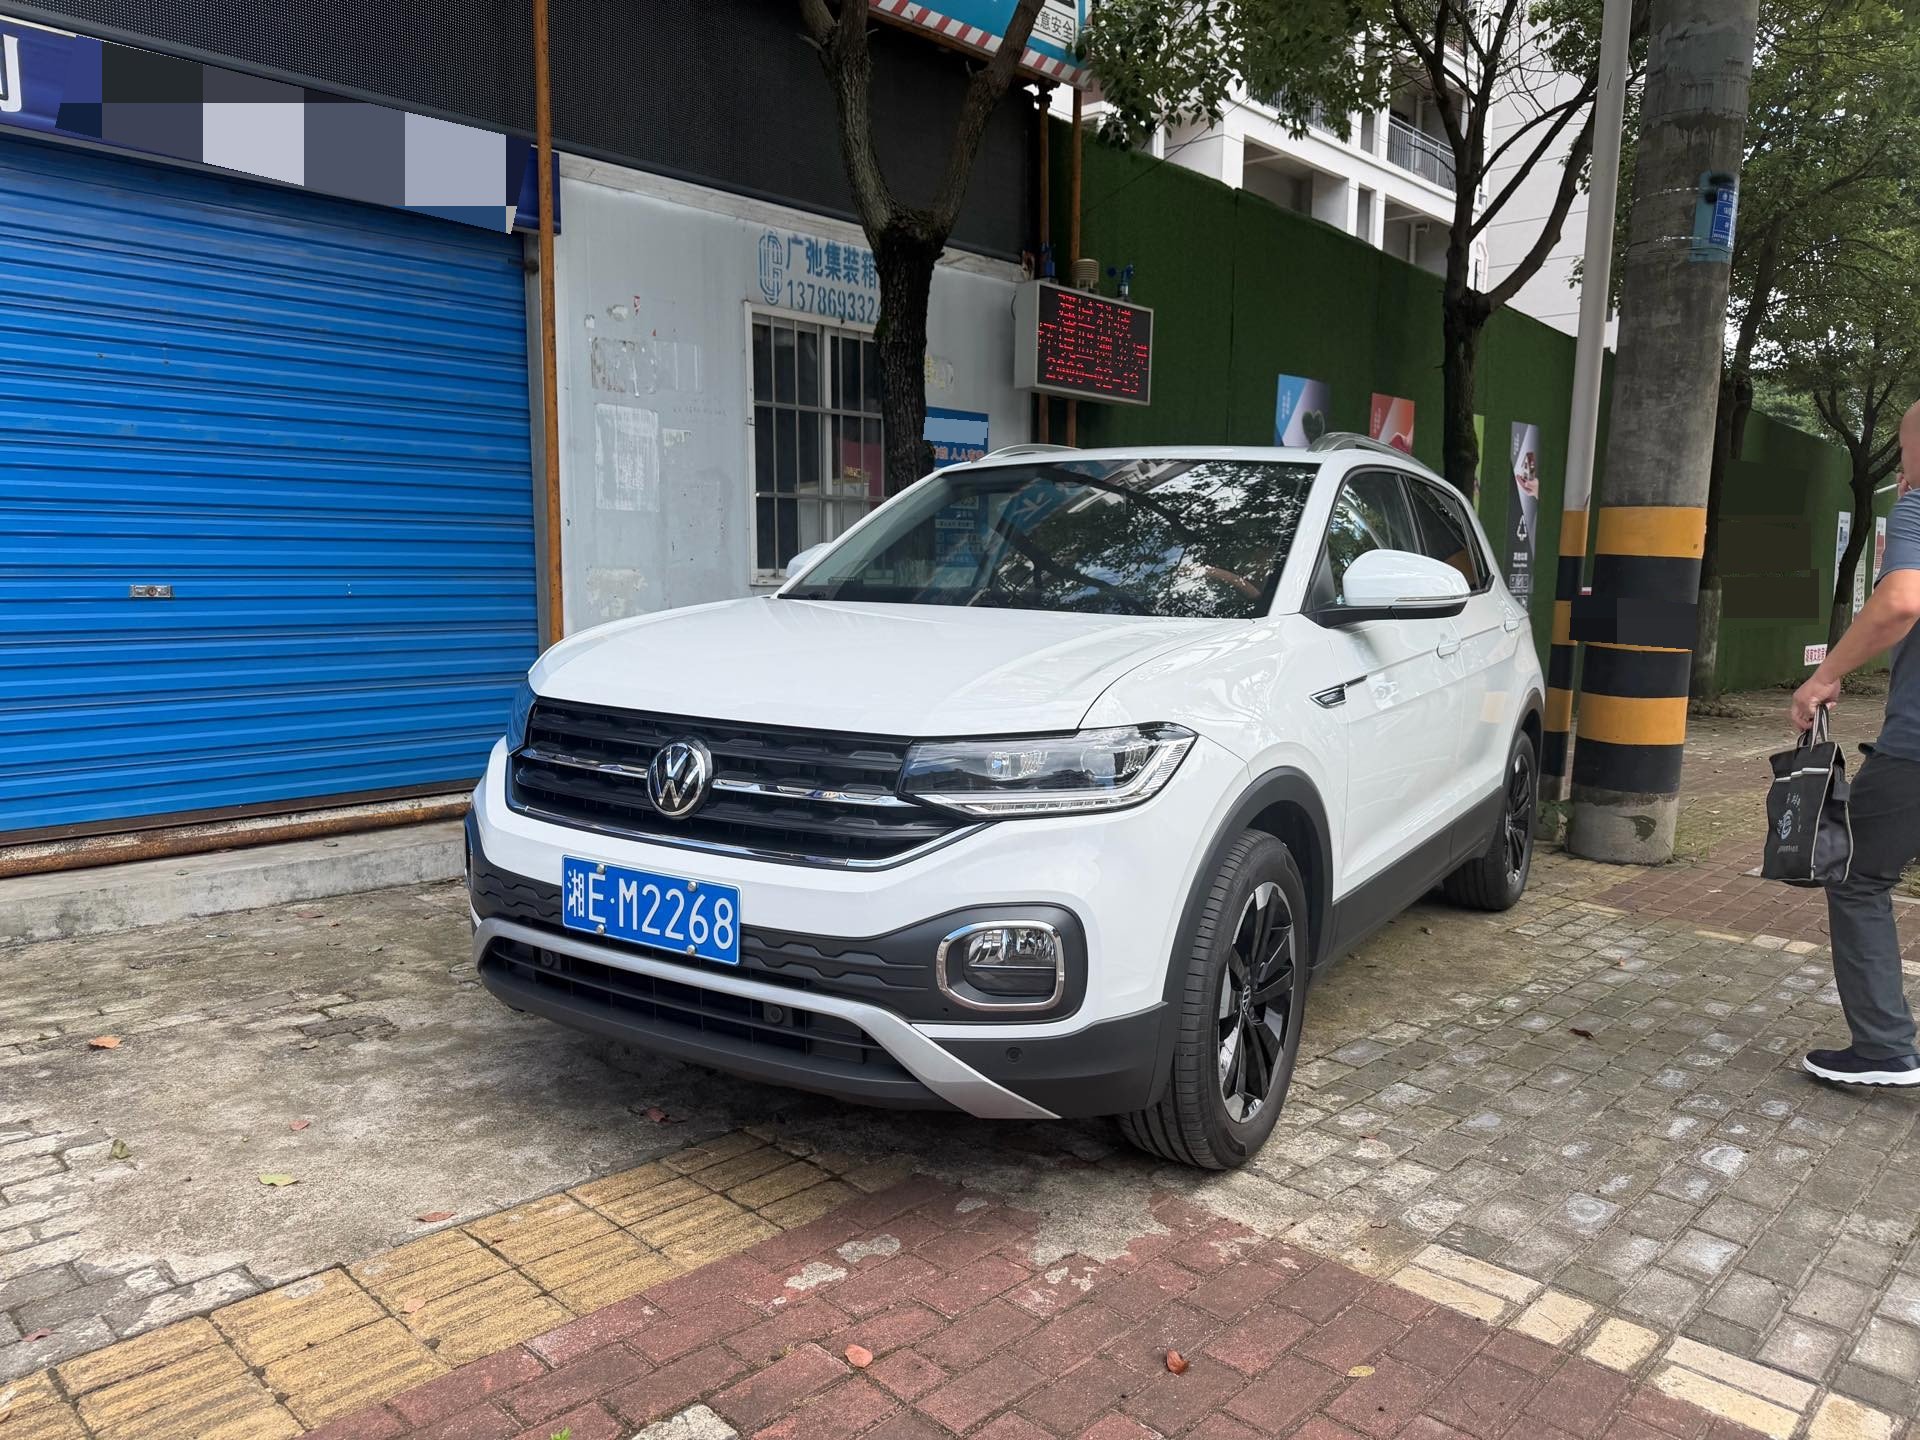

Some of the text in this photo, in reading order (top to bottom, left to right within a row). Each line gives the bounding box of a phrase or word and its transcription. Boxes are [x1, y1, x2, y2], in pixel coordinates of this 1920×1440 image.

[1034, 10, 1073, 40] 意安全
[787, 279, 881, 325] 137869332
[567, 868, 734, 950] 湘E·M2268
